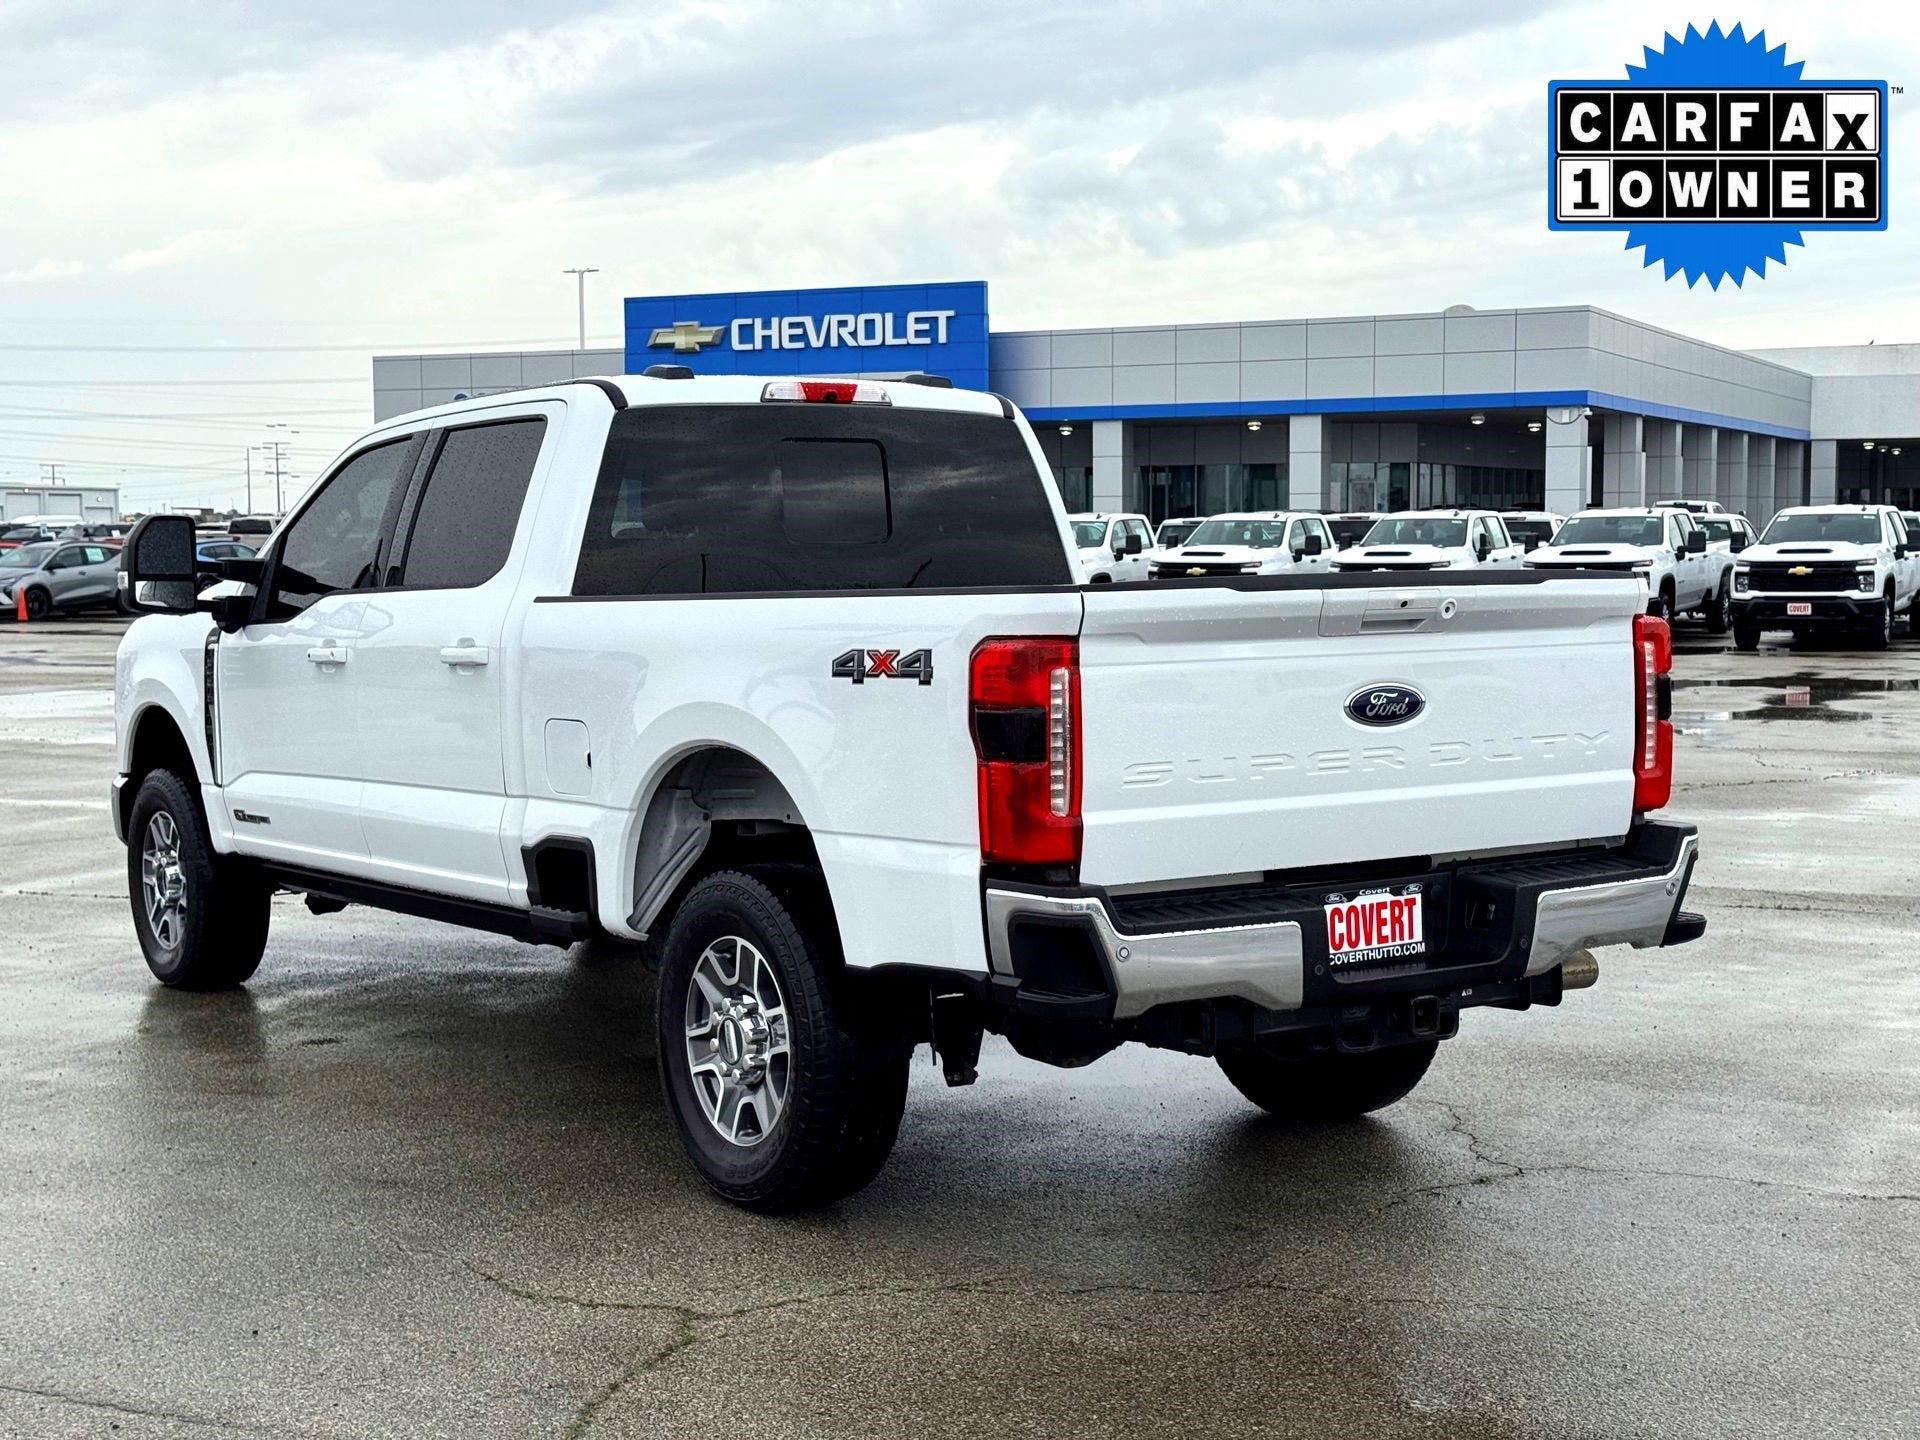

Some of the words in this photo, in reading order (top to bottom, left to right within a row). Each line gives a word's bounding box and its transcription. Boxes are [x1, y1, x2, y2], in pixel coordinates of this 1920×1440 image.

[731, 310, 955, 351] CHEVROLET
[1365, 692, 1409, 717] Ford
[1122, 745, 1406, 789] SUPER
[1430, 731, 1609, 767] DUTY
[1358, 887, 1391, 896] Covert
[1329, 897, 1417, 952] COVERT
